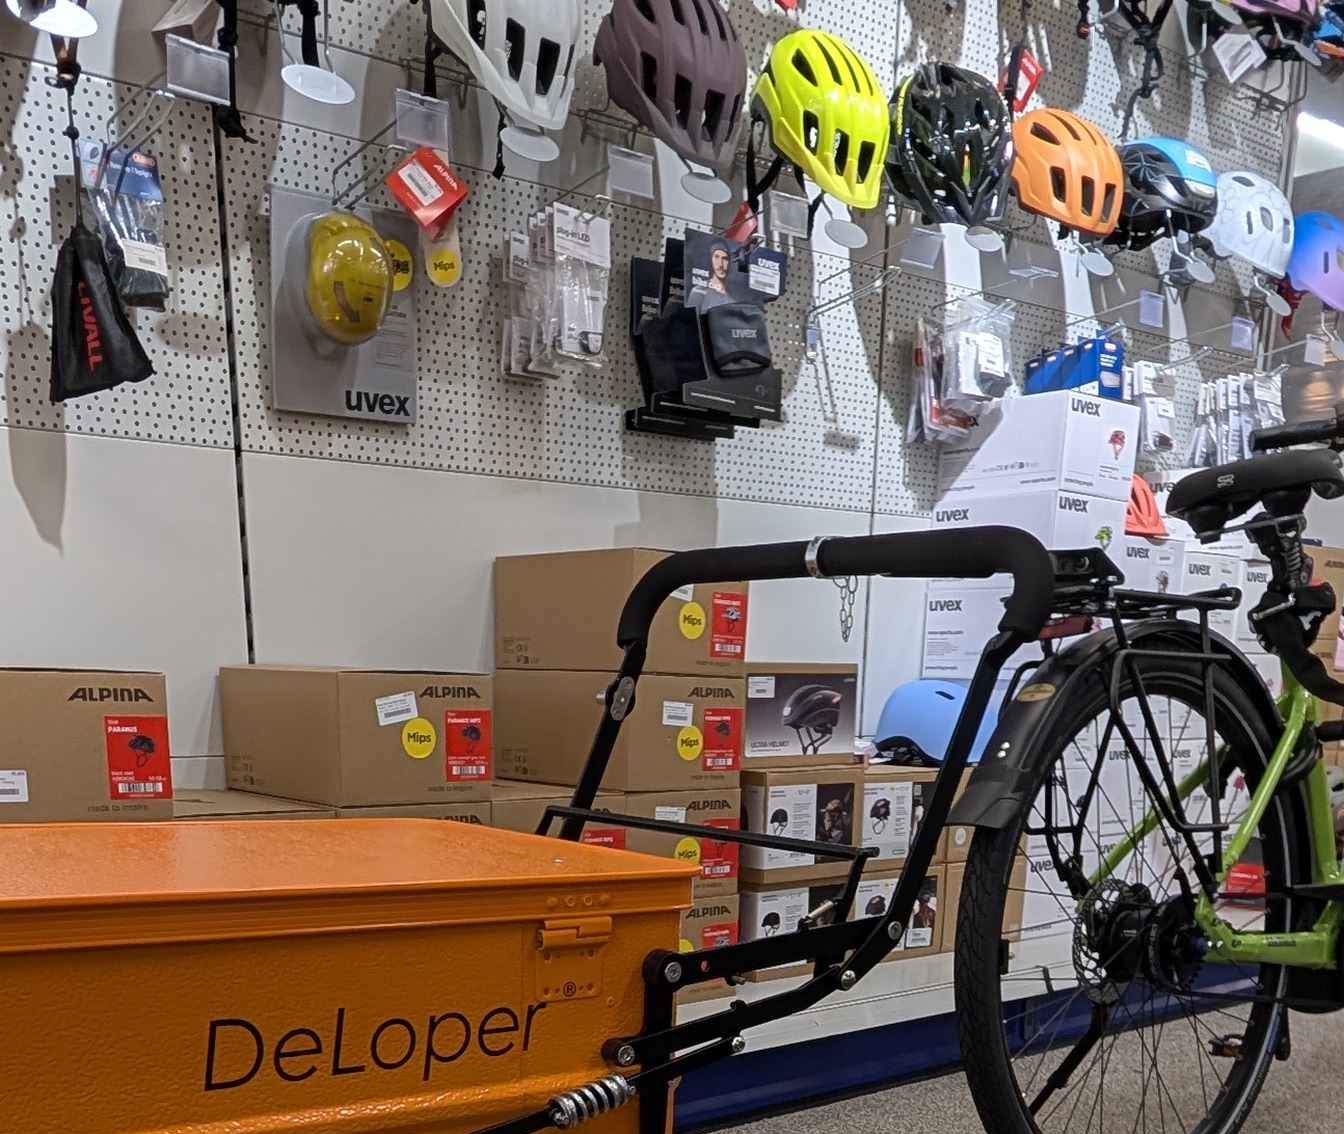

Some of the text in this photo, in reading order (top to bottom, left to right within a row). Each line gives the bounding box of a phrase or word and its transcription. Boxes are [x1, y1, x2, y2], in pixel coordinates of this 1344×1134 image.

[433, 163, 458, 190] ALPINA
[433, 259, 455, 272] Mips
[757, 257, 780, 268] uvex
[731, 328, 757, 339] uvex
[345, 390, 410, 417] uvex
[1071, 397, 1102, 417] uvex
[1150, 482, 1177, 493] uve
[1058, 495, 1089, 514] uvex
[935, 507, 970, 522] uvex
[1126, 546, 1150, 559] uvex
[1188, 563, 1211, 577] uvex
[929, 600, 963, 612] uvex
[682, 614, 702, 627] Mips
[67, 681, 155, 702] ALPINA
[418, 685, 482, 700] ALPINA
[688, 686, 735, 700] ALPINA
[406, 731, 432, 745] Mips
[680, 737, 700, 749] Mips
[685, 799, 733, 812] ALPINA
[677, 848, 698, 860] Mips
[684, 905, 732, 920] ALPINA
[203, 1002, 548, 1093] DeLoper
